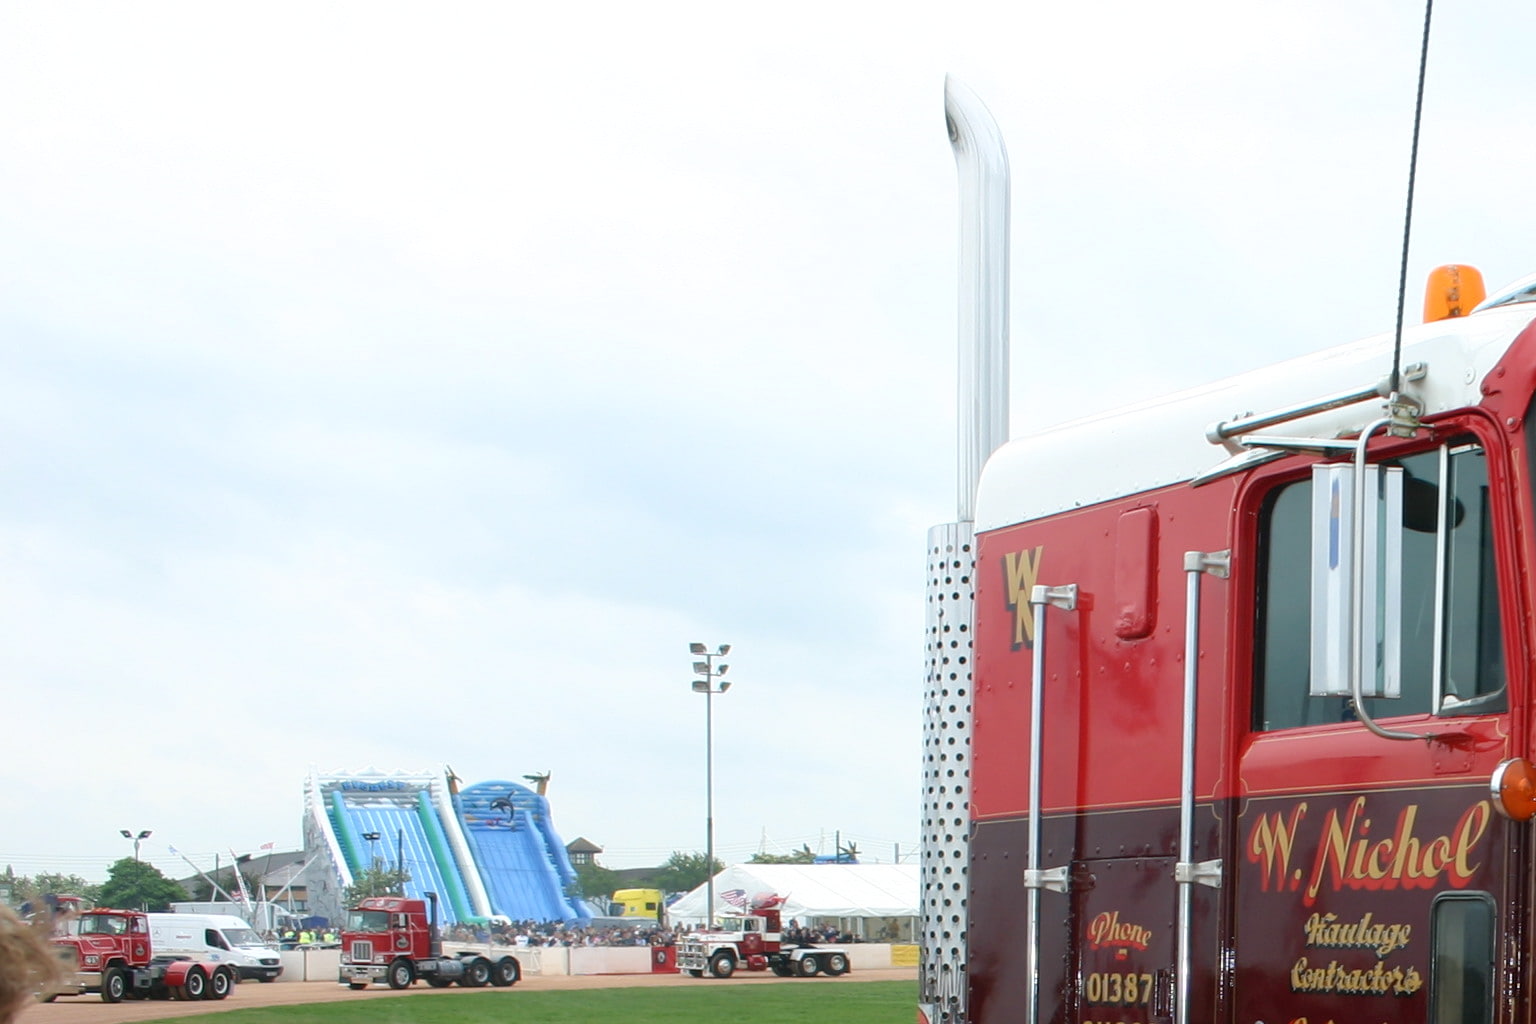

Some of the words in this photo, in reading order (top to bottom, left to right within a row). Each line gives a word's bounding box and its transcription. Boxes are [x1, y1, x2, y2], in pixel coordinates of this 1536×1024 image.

[1305, 796, 1491, 905] Nichol
[1088, 911, 1152, 949] Phone
[1304, 912, 1411, 957] Haulage
[1087, 973, 1153, 1004] 01387
[1291, 957, 1423, 994] Contractors
